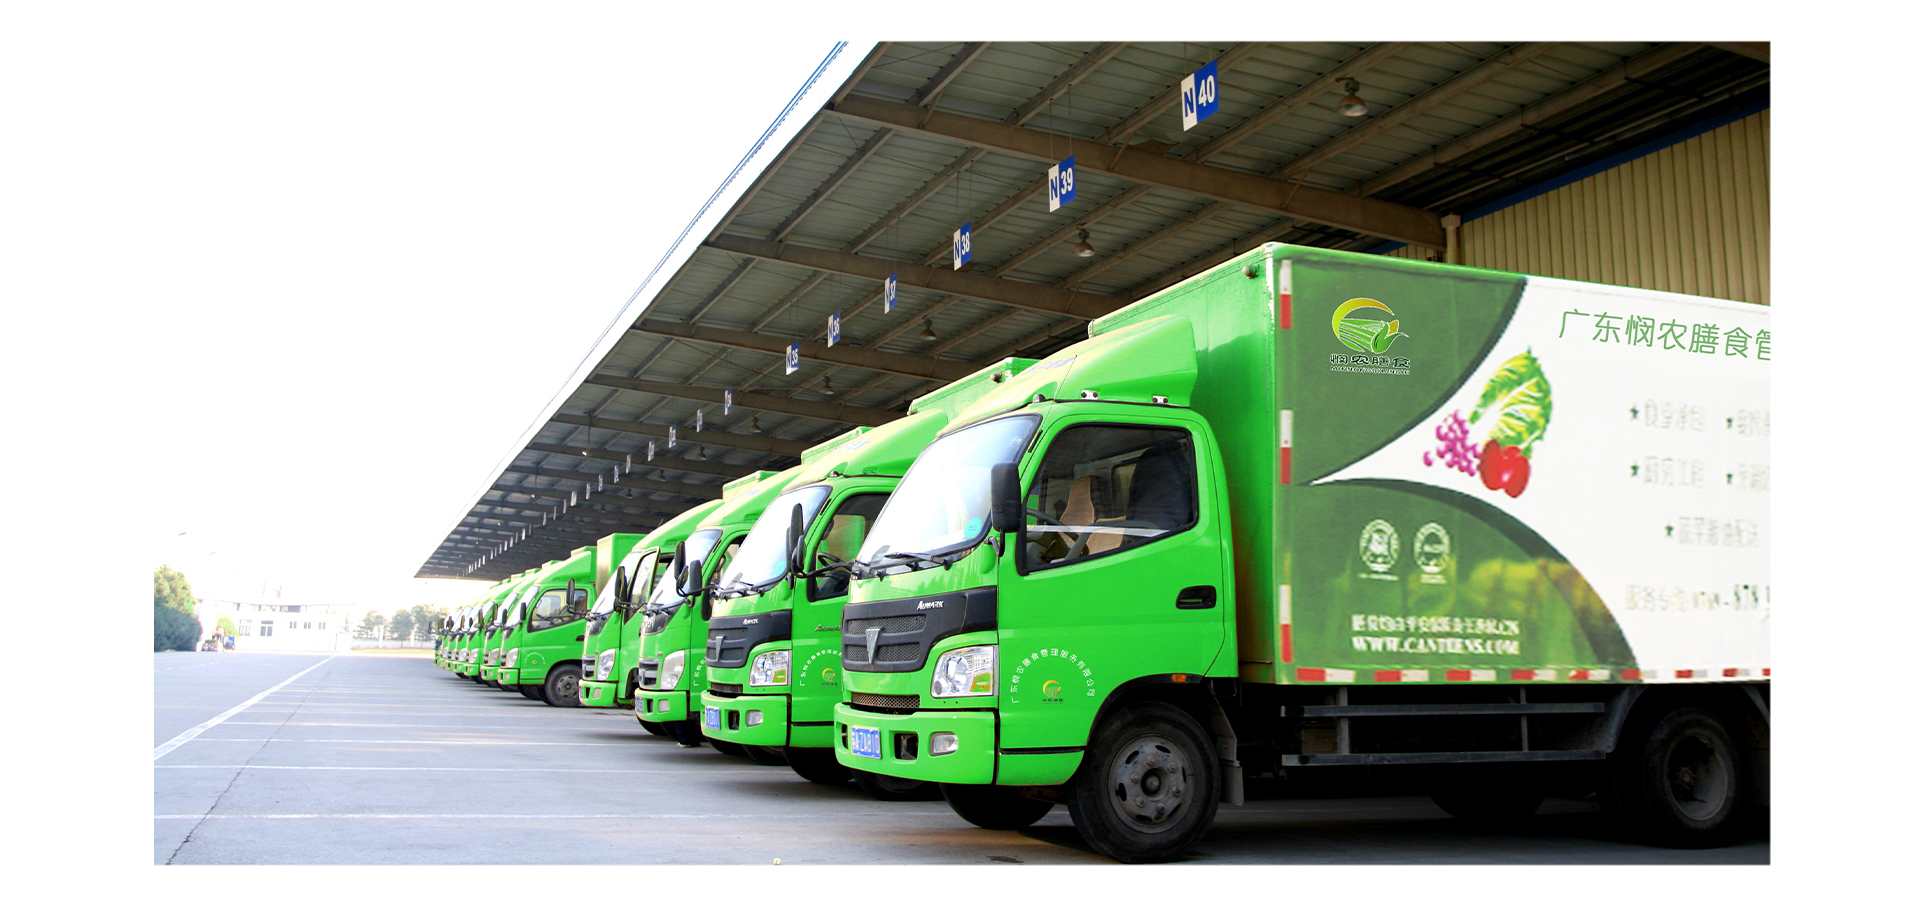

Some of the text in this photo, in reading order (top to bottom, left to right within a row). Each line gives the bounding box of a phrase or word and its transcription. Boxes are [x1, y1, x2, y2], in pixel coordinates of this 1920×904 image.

[1184, 75, 1215, 118] N 40
[1050, 167, 1073, 201] N 39
[954, 231, 970, 261] N 38
[890, 280, 896, 302] 37
[833, 317, 840, 337] 36
[791, 348, 798, 365] 35
